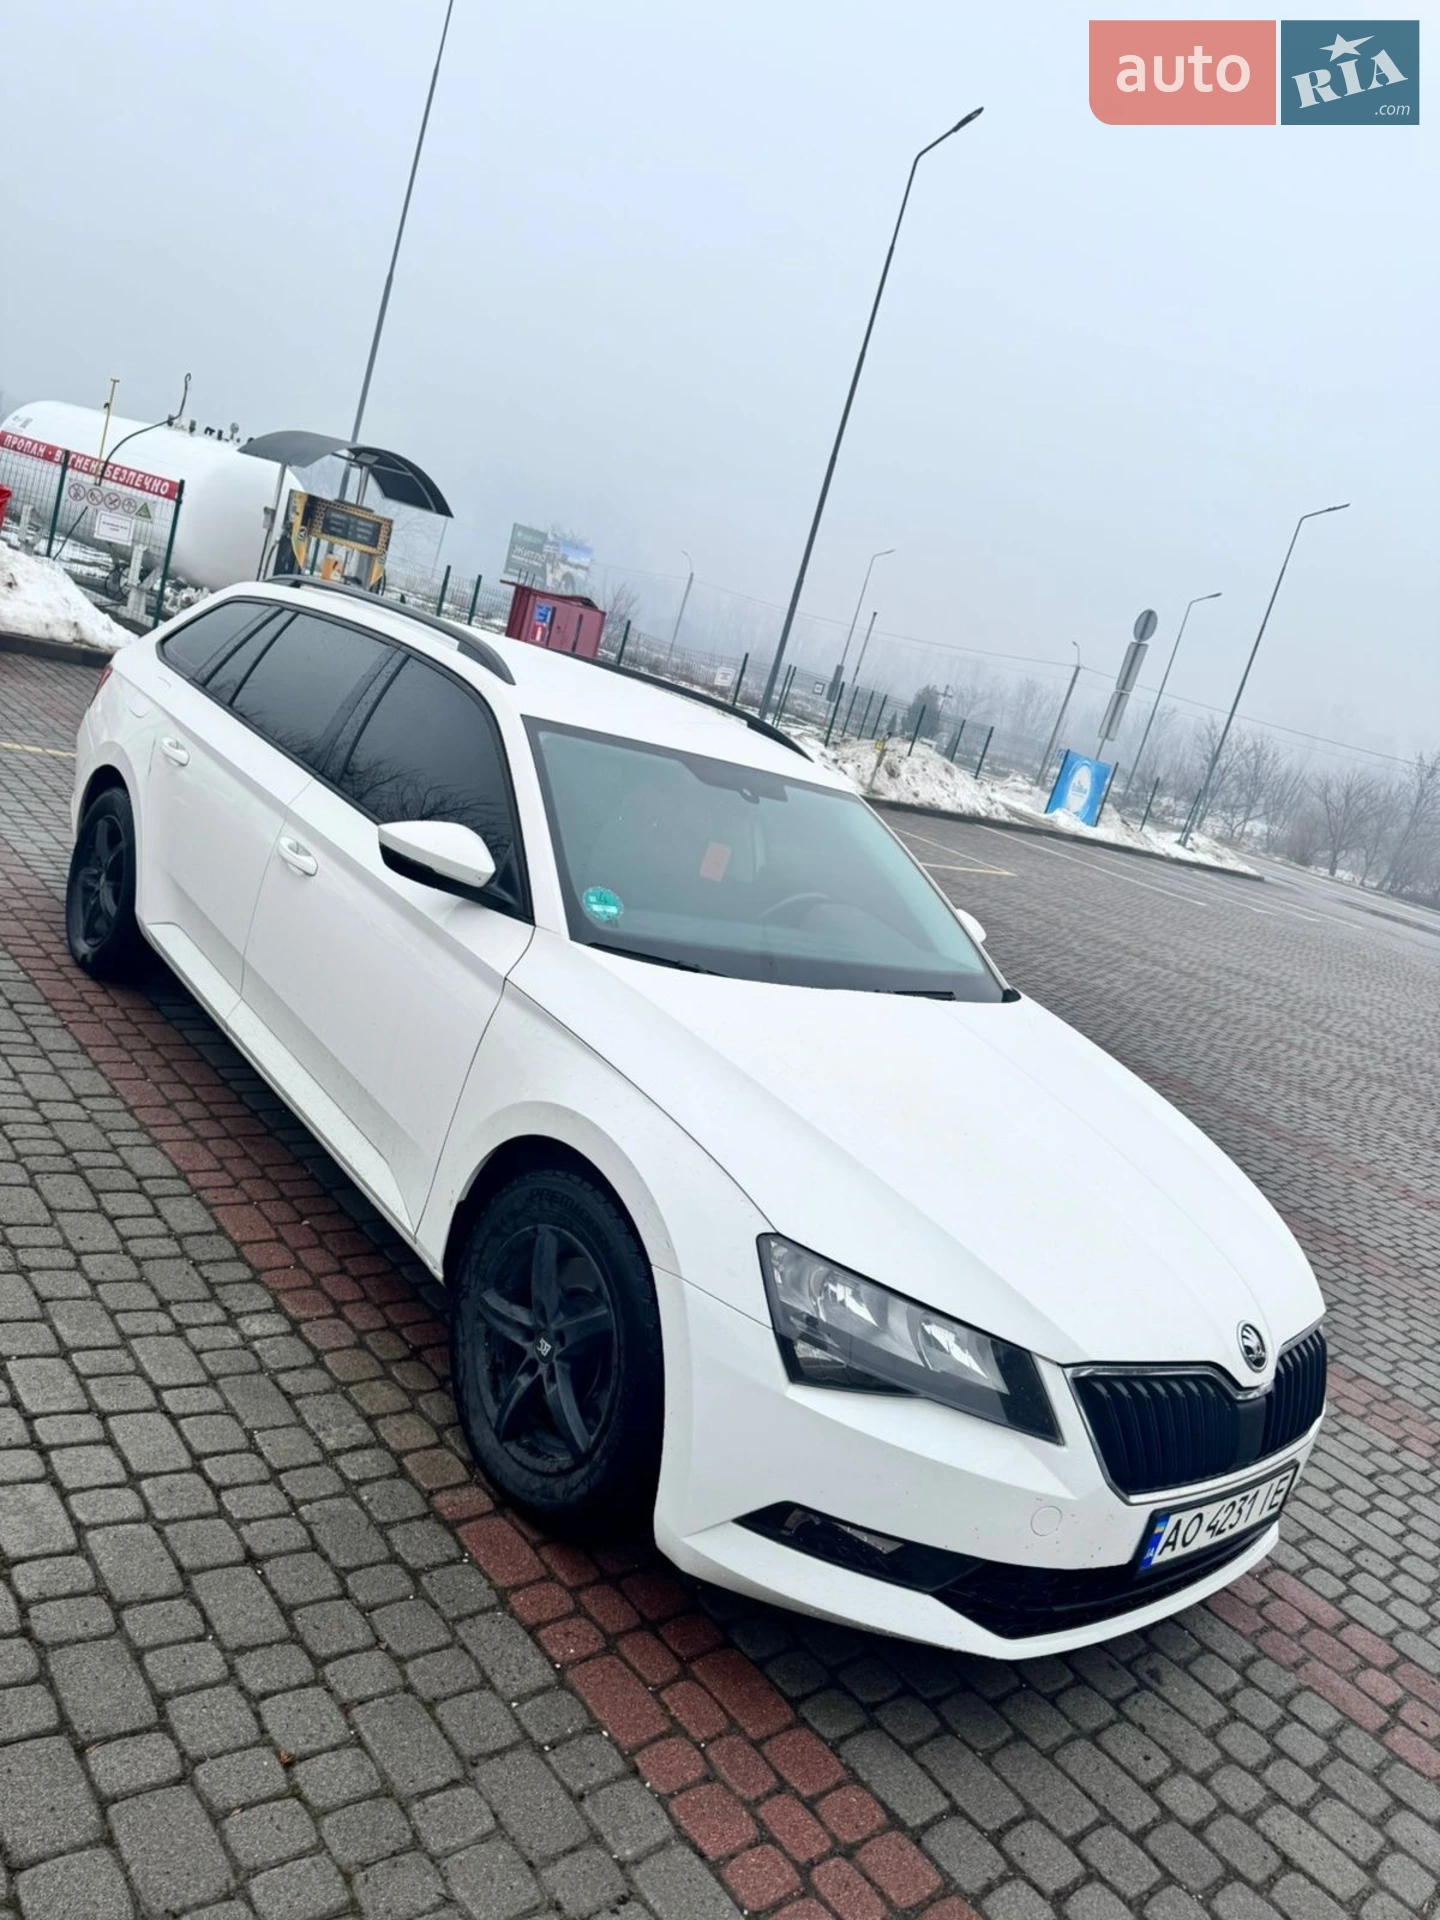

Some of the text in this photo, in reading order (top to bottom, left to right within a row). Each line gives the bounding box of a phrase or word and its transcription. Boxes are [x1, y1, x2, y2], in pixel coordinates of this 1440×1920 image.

[4, 435, 169, 495] ПРОПАН ВГНЕНЕБЕЗПЕЧНО
[1157, 1475, 1290, 1556] AO 4231 IE
